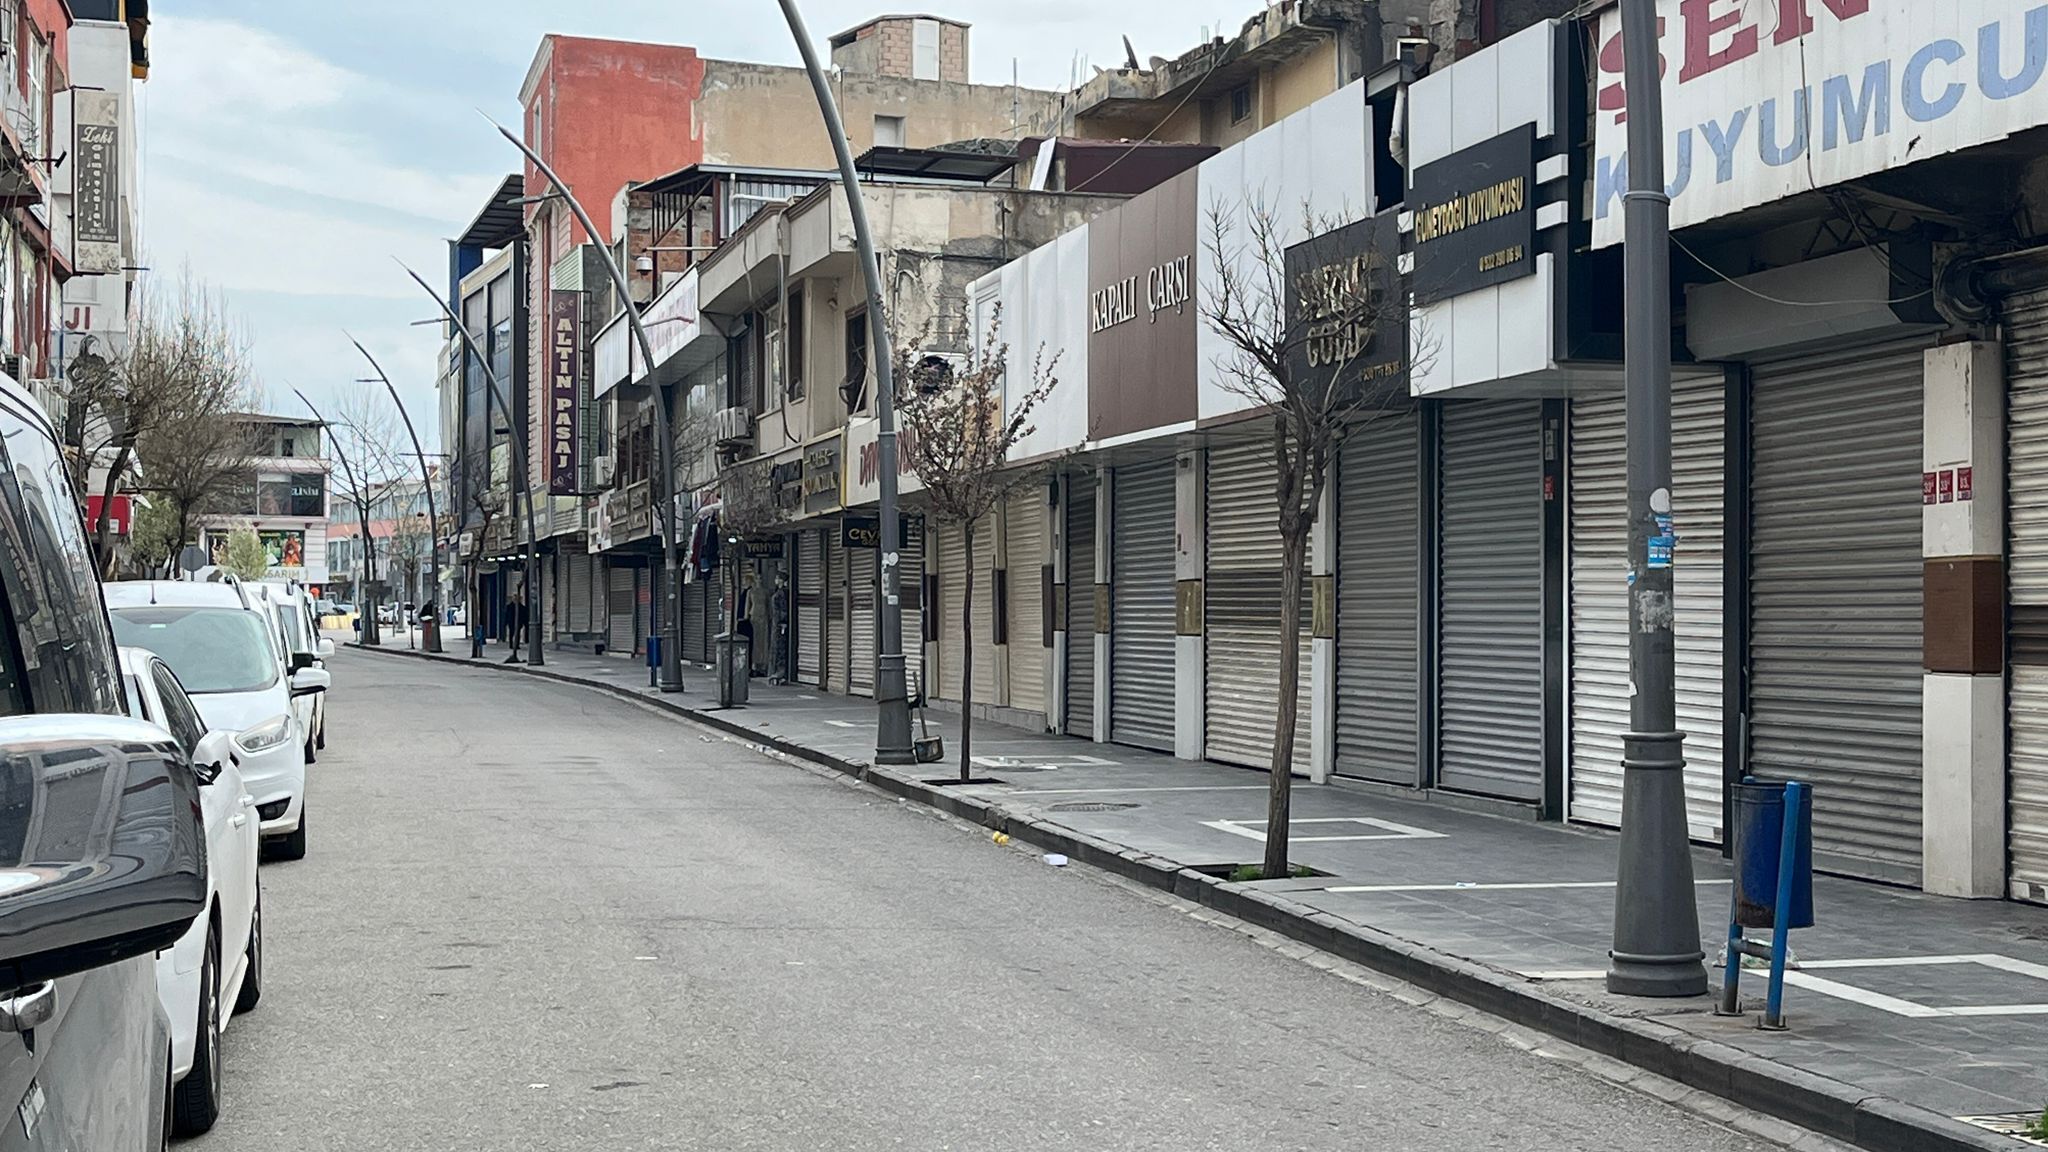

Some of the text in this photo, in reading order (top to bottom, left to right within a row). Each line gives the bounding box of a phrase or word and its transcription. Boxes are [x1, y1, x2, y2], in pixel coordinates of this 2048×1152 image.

[1467, 176, 1524, 227] KUYUMCUSU
[1092, 255, 1190, 333] KAPALI ÇARŞI
[555, 318, 573, 468] ALTIN PASAJ
